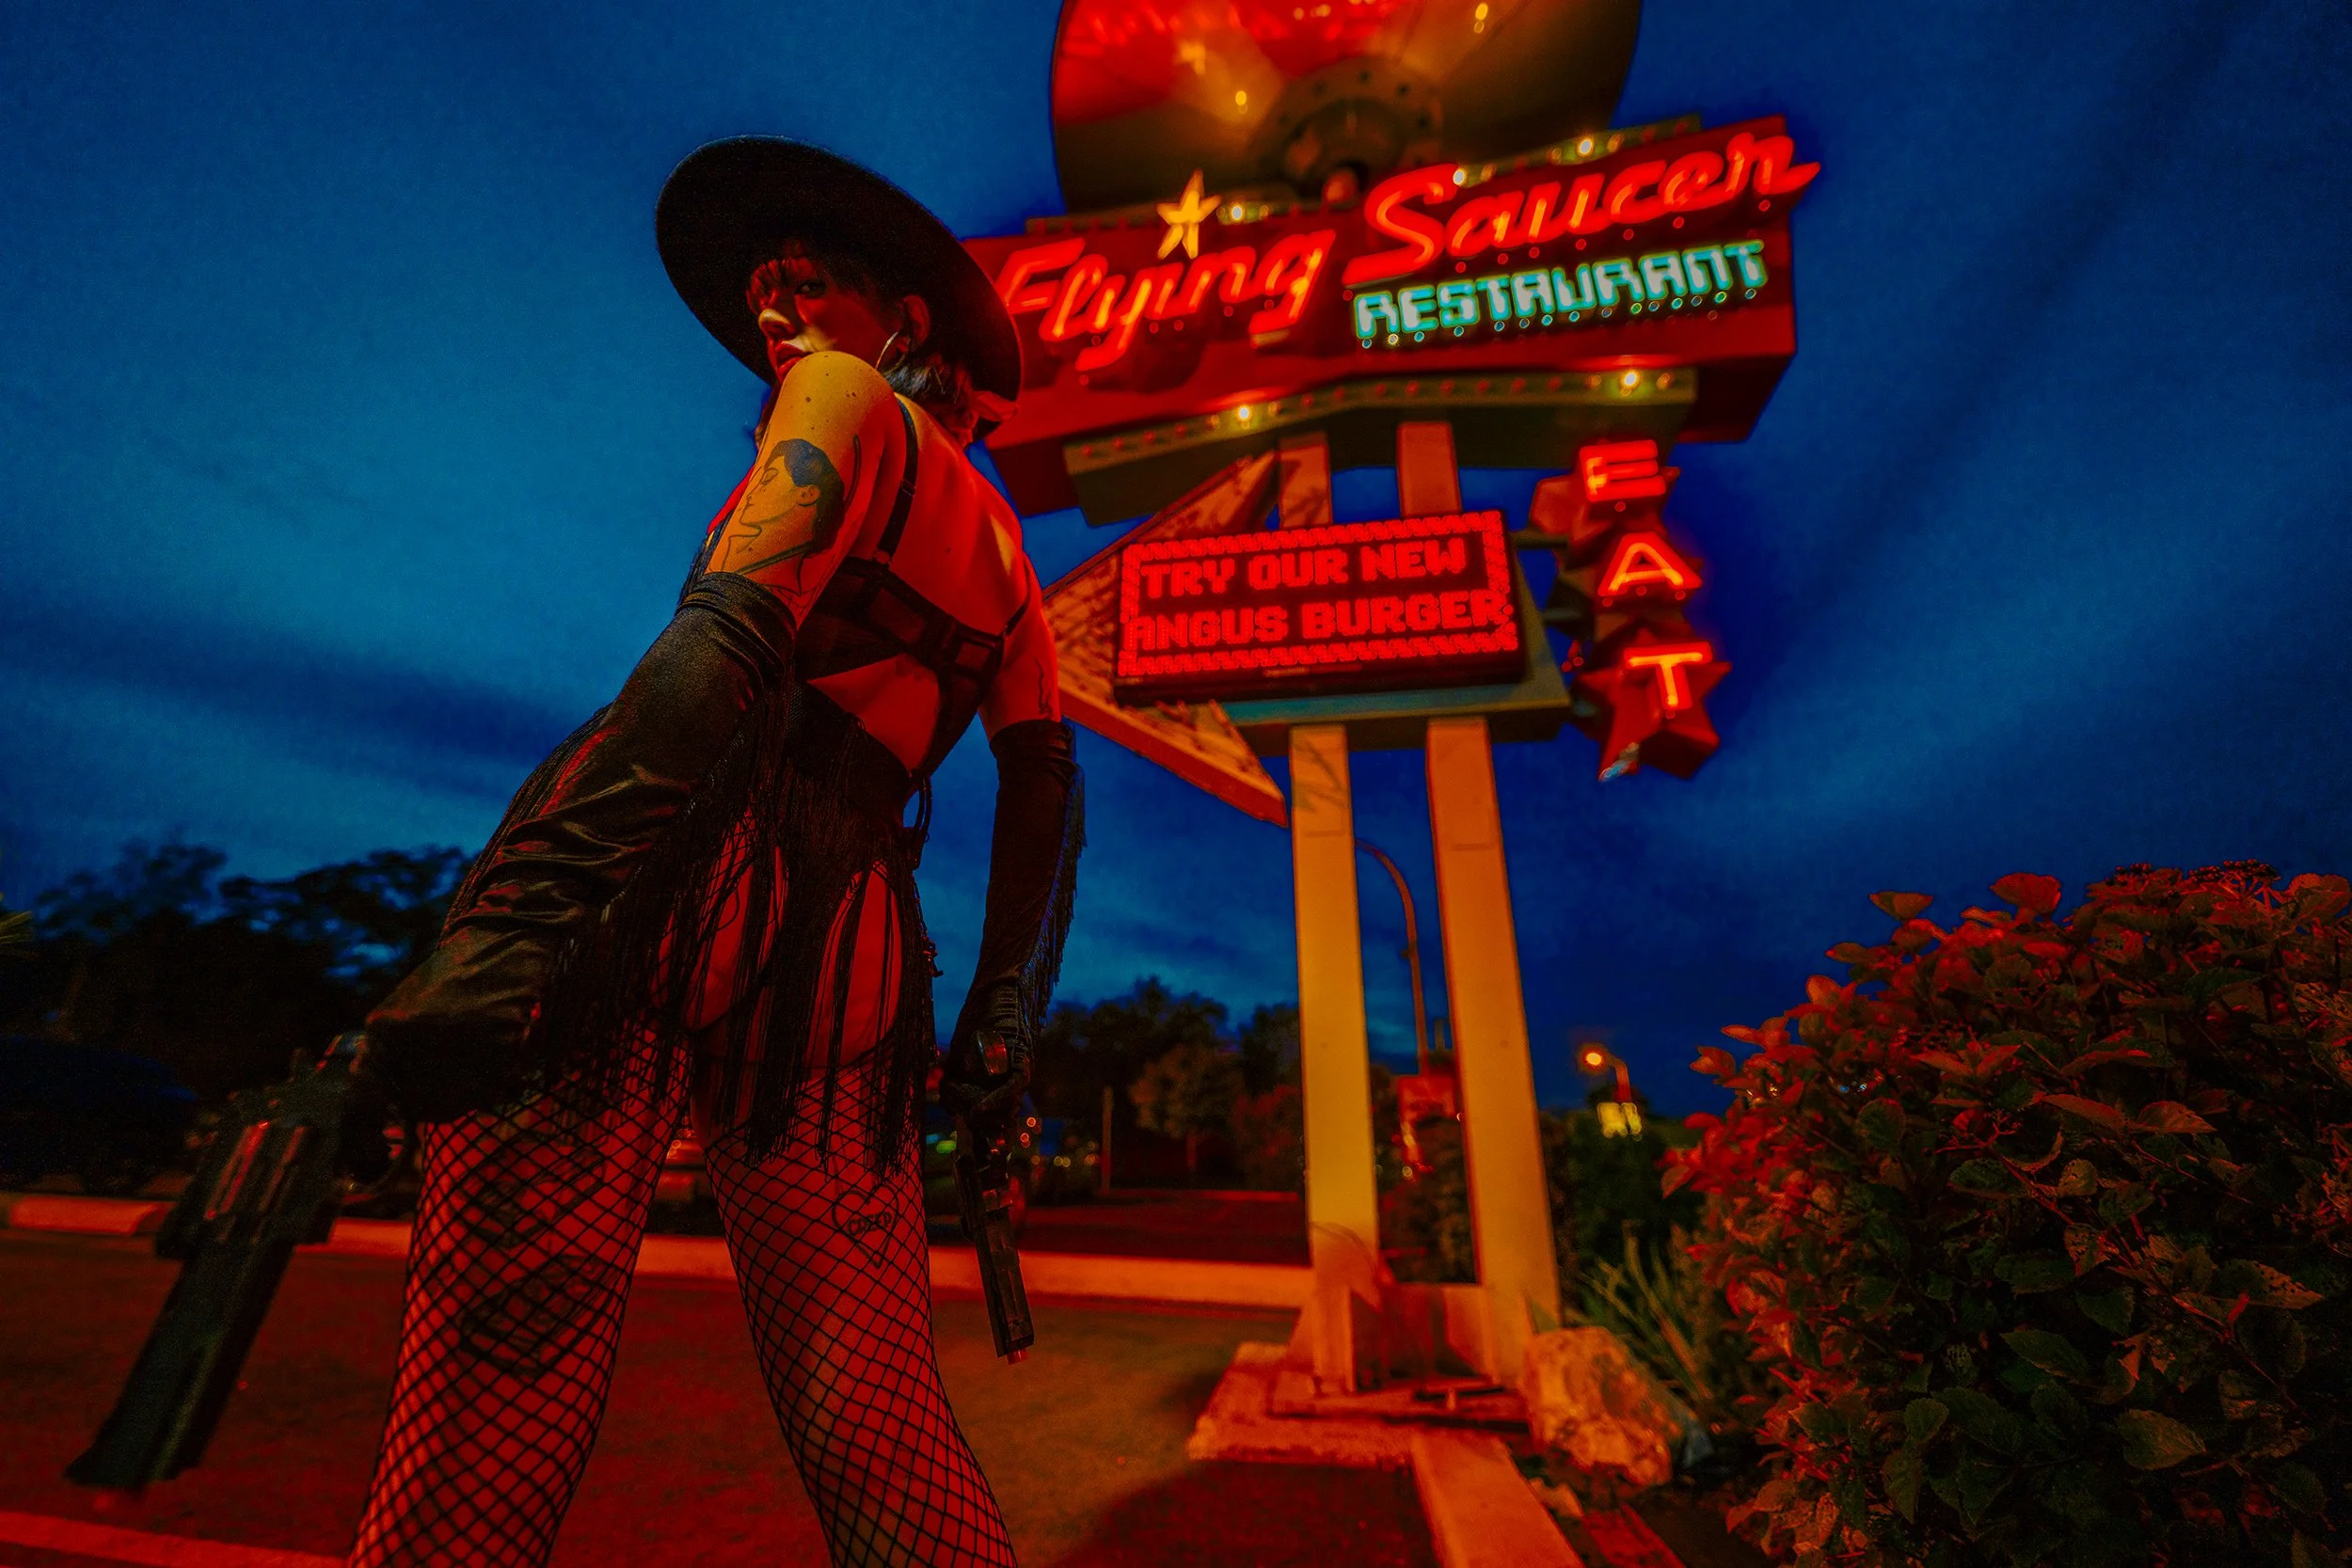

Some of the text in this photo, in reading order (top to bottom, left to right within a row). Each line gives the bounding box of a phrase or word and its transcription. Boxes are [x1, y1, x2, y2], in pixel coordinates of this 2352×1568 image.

[996, 132, 1821, 372] Flying Saucer
[1353, 238, 1769, 339] RESTAURANT
[1139, 537, 1466, 599] TRY OUR NEW
[1580, 439, 1713, 710] EAT
[1122, 589, 1510, 651] ANGUS BURGER
